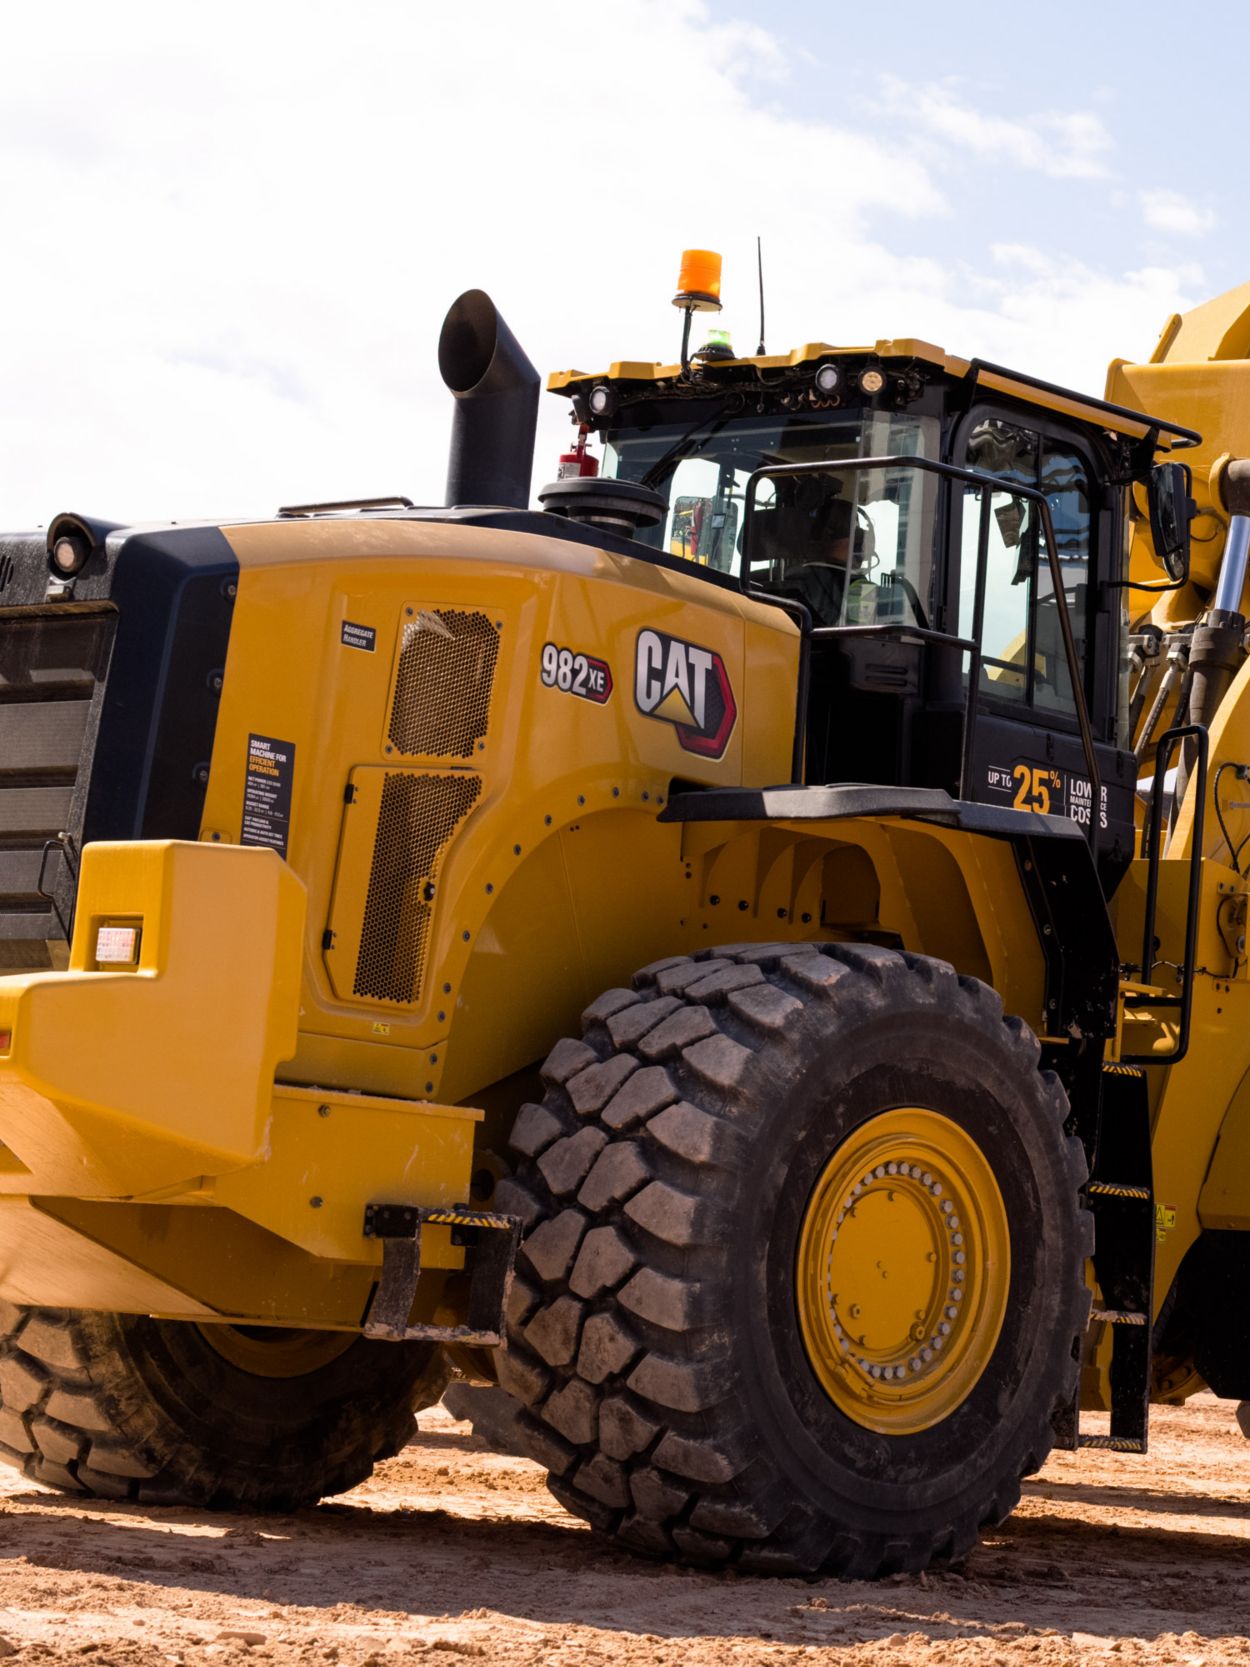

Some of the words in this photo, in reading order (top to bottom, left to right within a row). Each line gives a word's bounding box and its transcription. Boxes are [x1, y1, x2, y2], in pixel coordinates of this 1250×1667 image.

[344, 624, 374, 639] AGGREGATE
[343, 633, 367, 647] HANDLER
[636, 629, 713, 730] CAT
[250, 739, 271, 751] SMART
[249, 755, 275, 768] EFFICIENT
[250, 747, 277, 761] MACHINE
[275, 753, 287, 763] FOR
[249, 763, 279, 777] OPERATION
[988, 771, 999, 785] UP
[1001, 774, 1012, 788] TO
[1070, 779, 1107, 803] LOWR
[1070, 795, 1107, 812] MAINTECE
[1070, 804, 1108, 829] COSS
